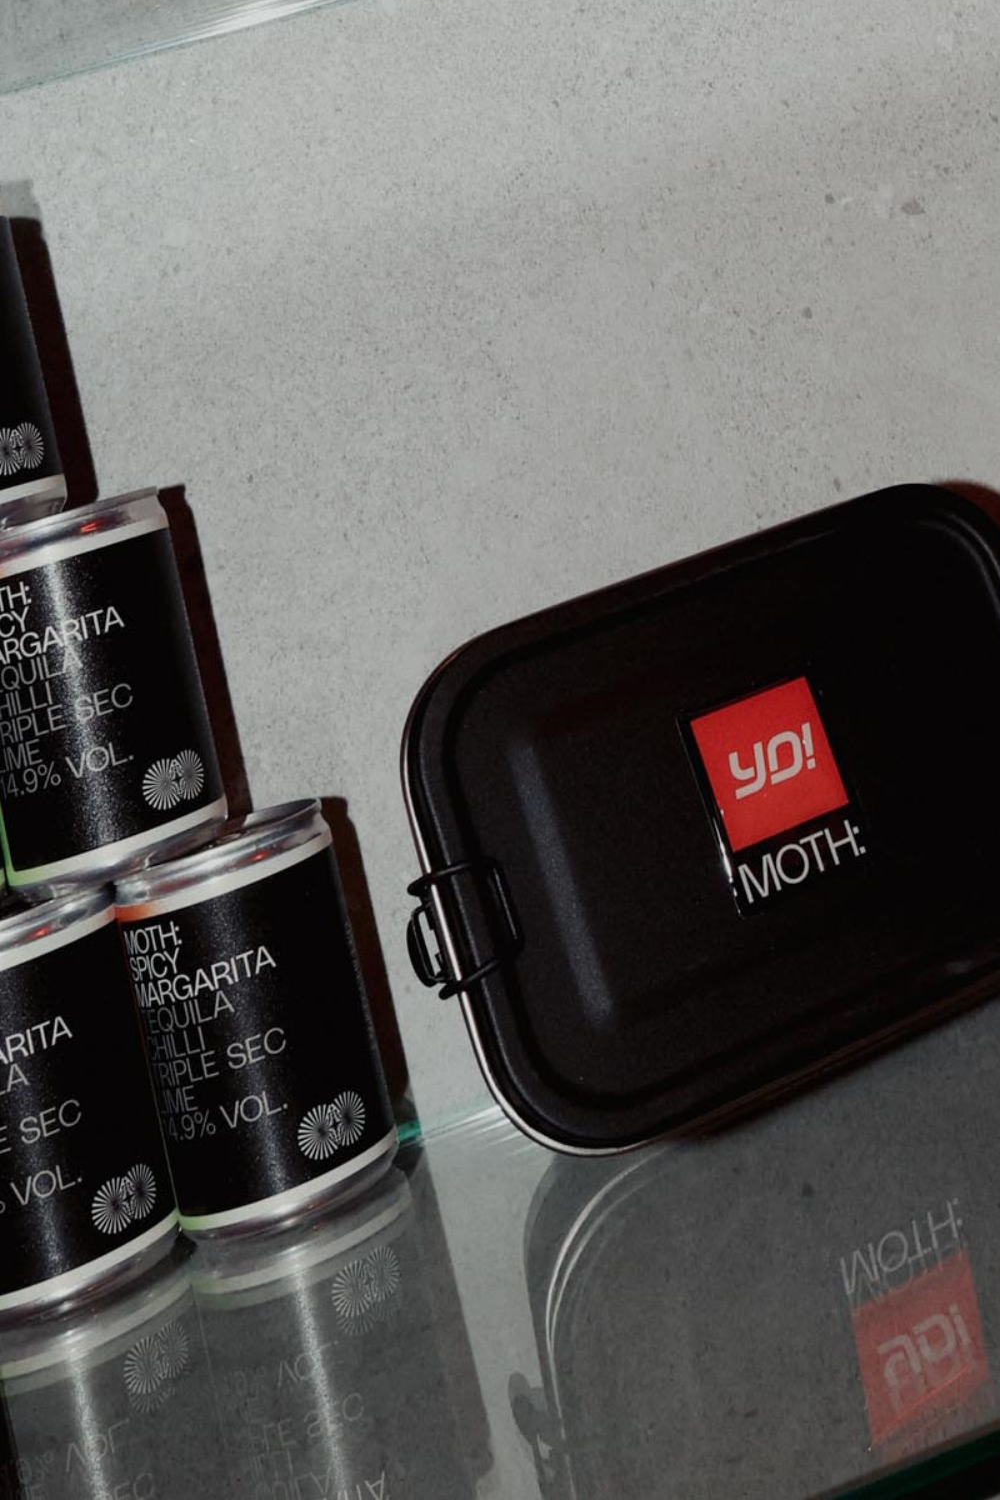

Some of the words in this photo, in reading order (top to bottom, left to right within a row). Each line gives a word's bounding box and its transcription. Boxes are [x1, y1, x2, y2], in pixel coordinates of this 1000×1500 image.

[0, 581, 32, 612] TH:
[0, 648, 83, 692] QUILA
[0, 681, 53, 718] HILLI
[0, 703, 67, 745] RIPLE
[74, 683, 134, 724] SEC
[65, 742, 134, 779] VOL.
[738, 820, 866, 904] MOTH:
[124, 920, 182, 955] MOTH:
[130, 947, 180, 981] SPICY
[135, 945, 276, 1008] MARGARITA
[226, 1027, 286, 1070] SEC
[20, 1100, 82, 1144] SEC
[219, 1090, 288, 1128] VOL.
[10, 1165, 82, 1206] VOL.
